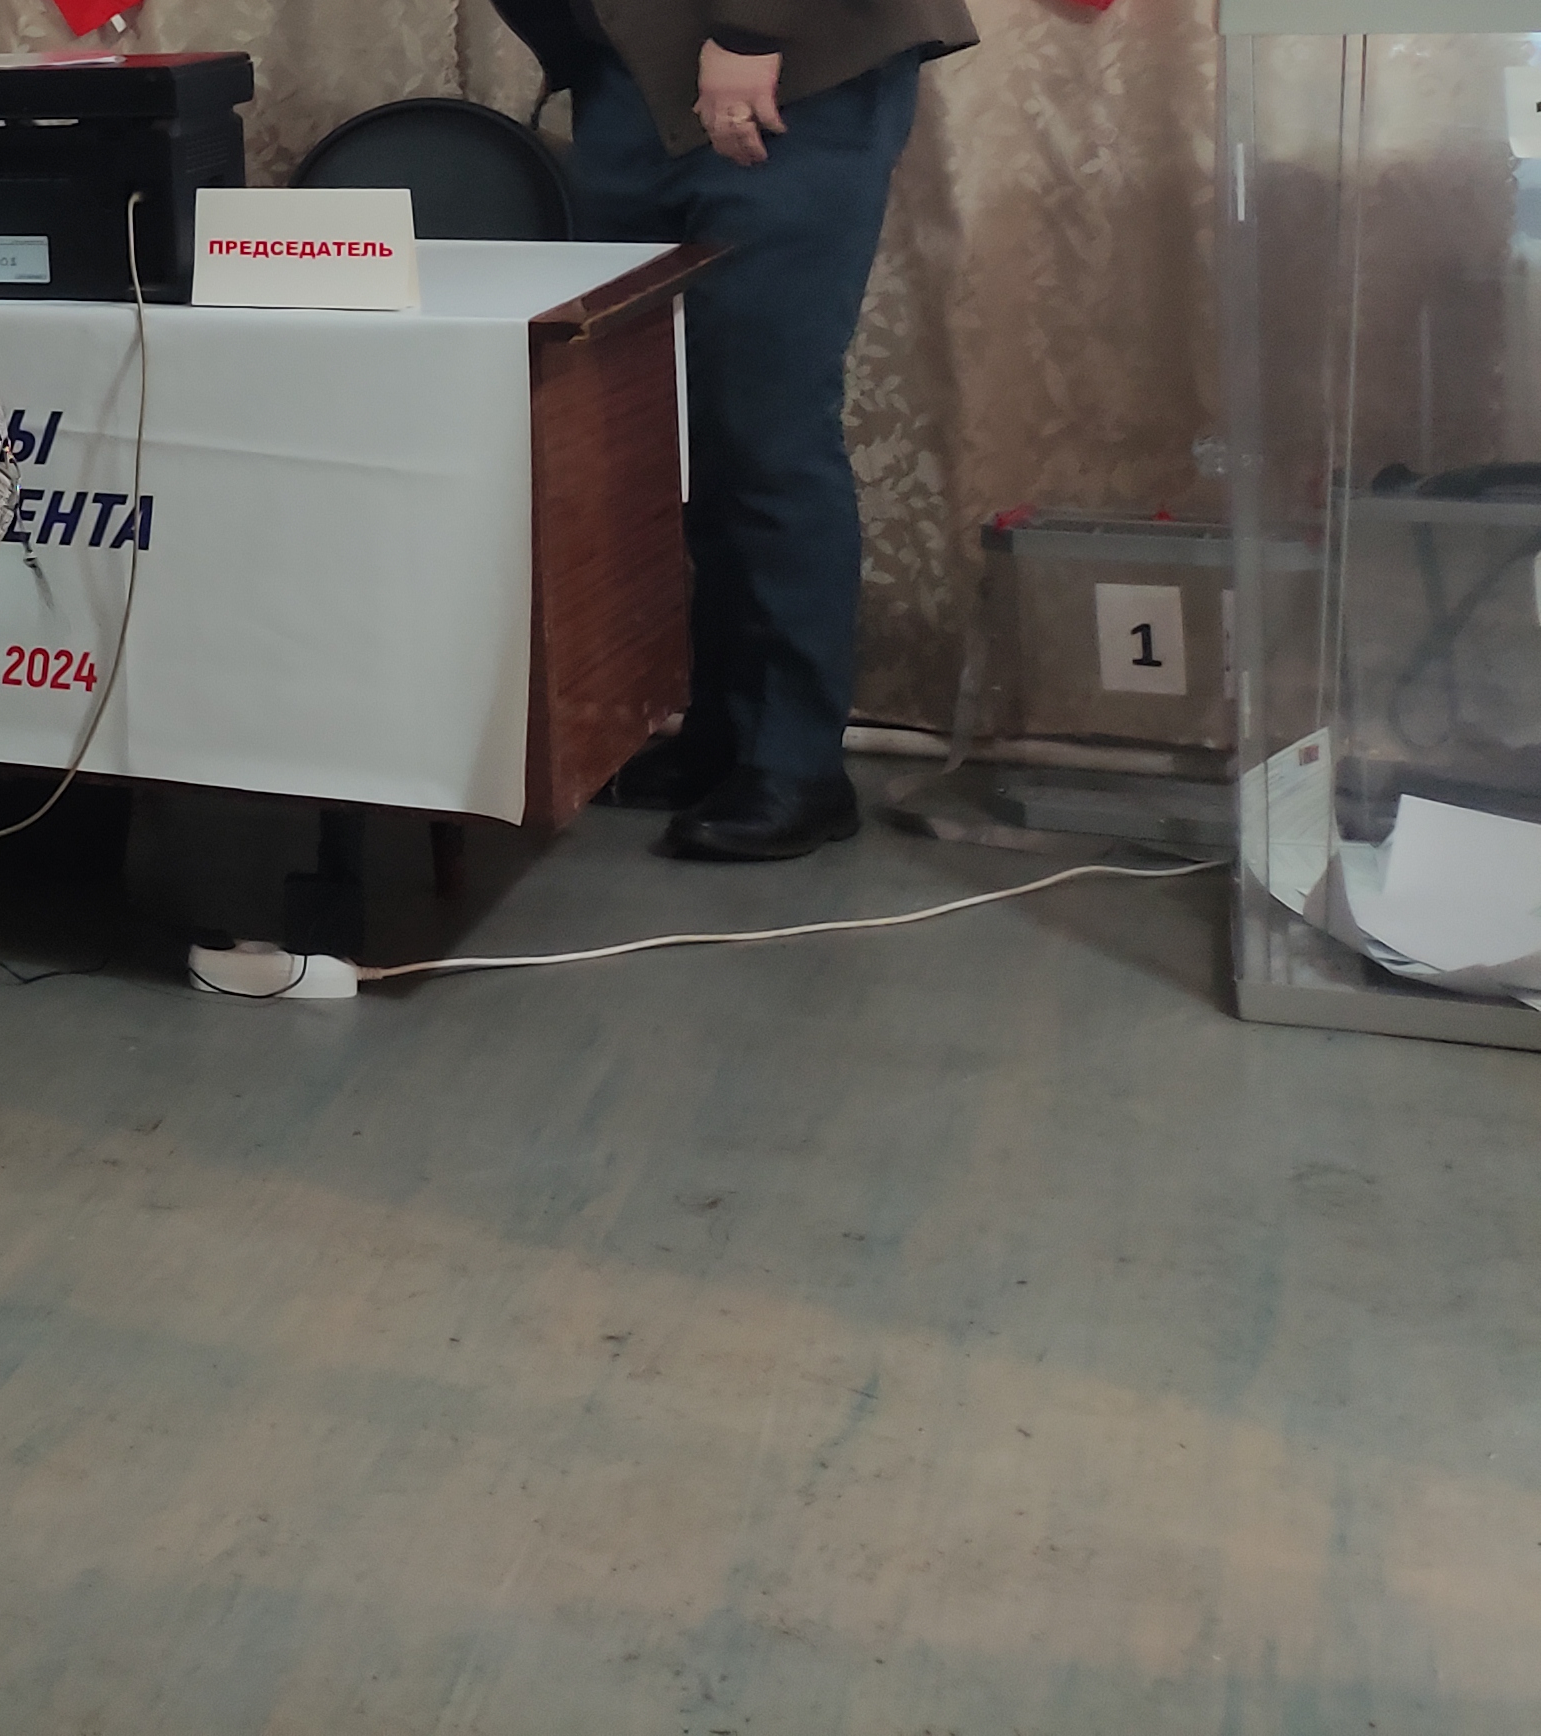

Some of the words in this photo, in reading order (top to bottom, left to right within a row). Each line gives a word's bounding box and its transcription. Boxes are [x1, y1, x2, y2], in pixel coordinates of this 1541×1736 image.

[208, 239, 394, 260] ПРЕДСЕДАТЕЛЬ
[1130, 623, 1163, 667] 1
[1, 645, 98, 692] 2024
